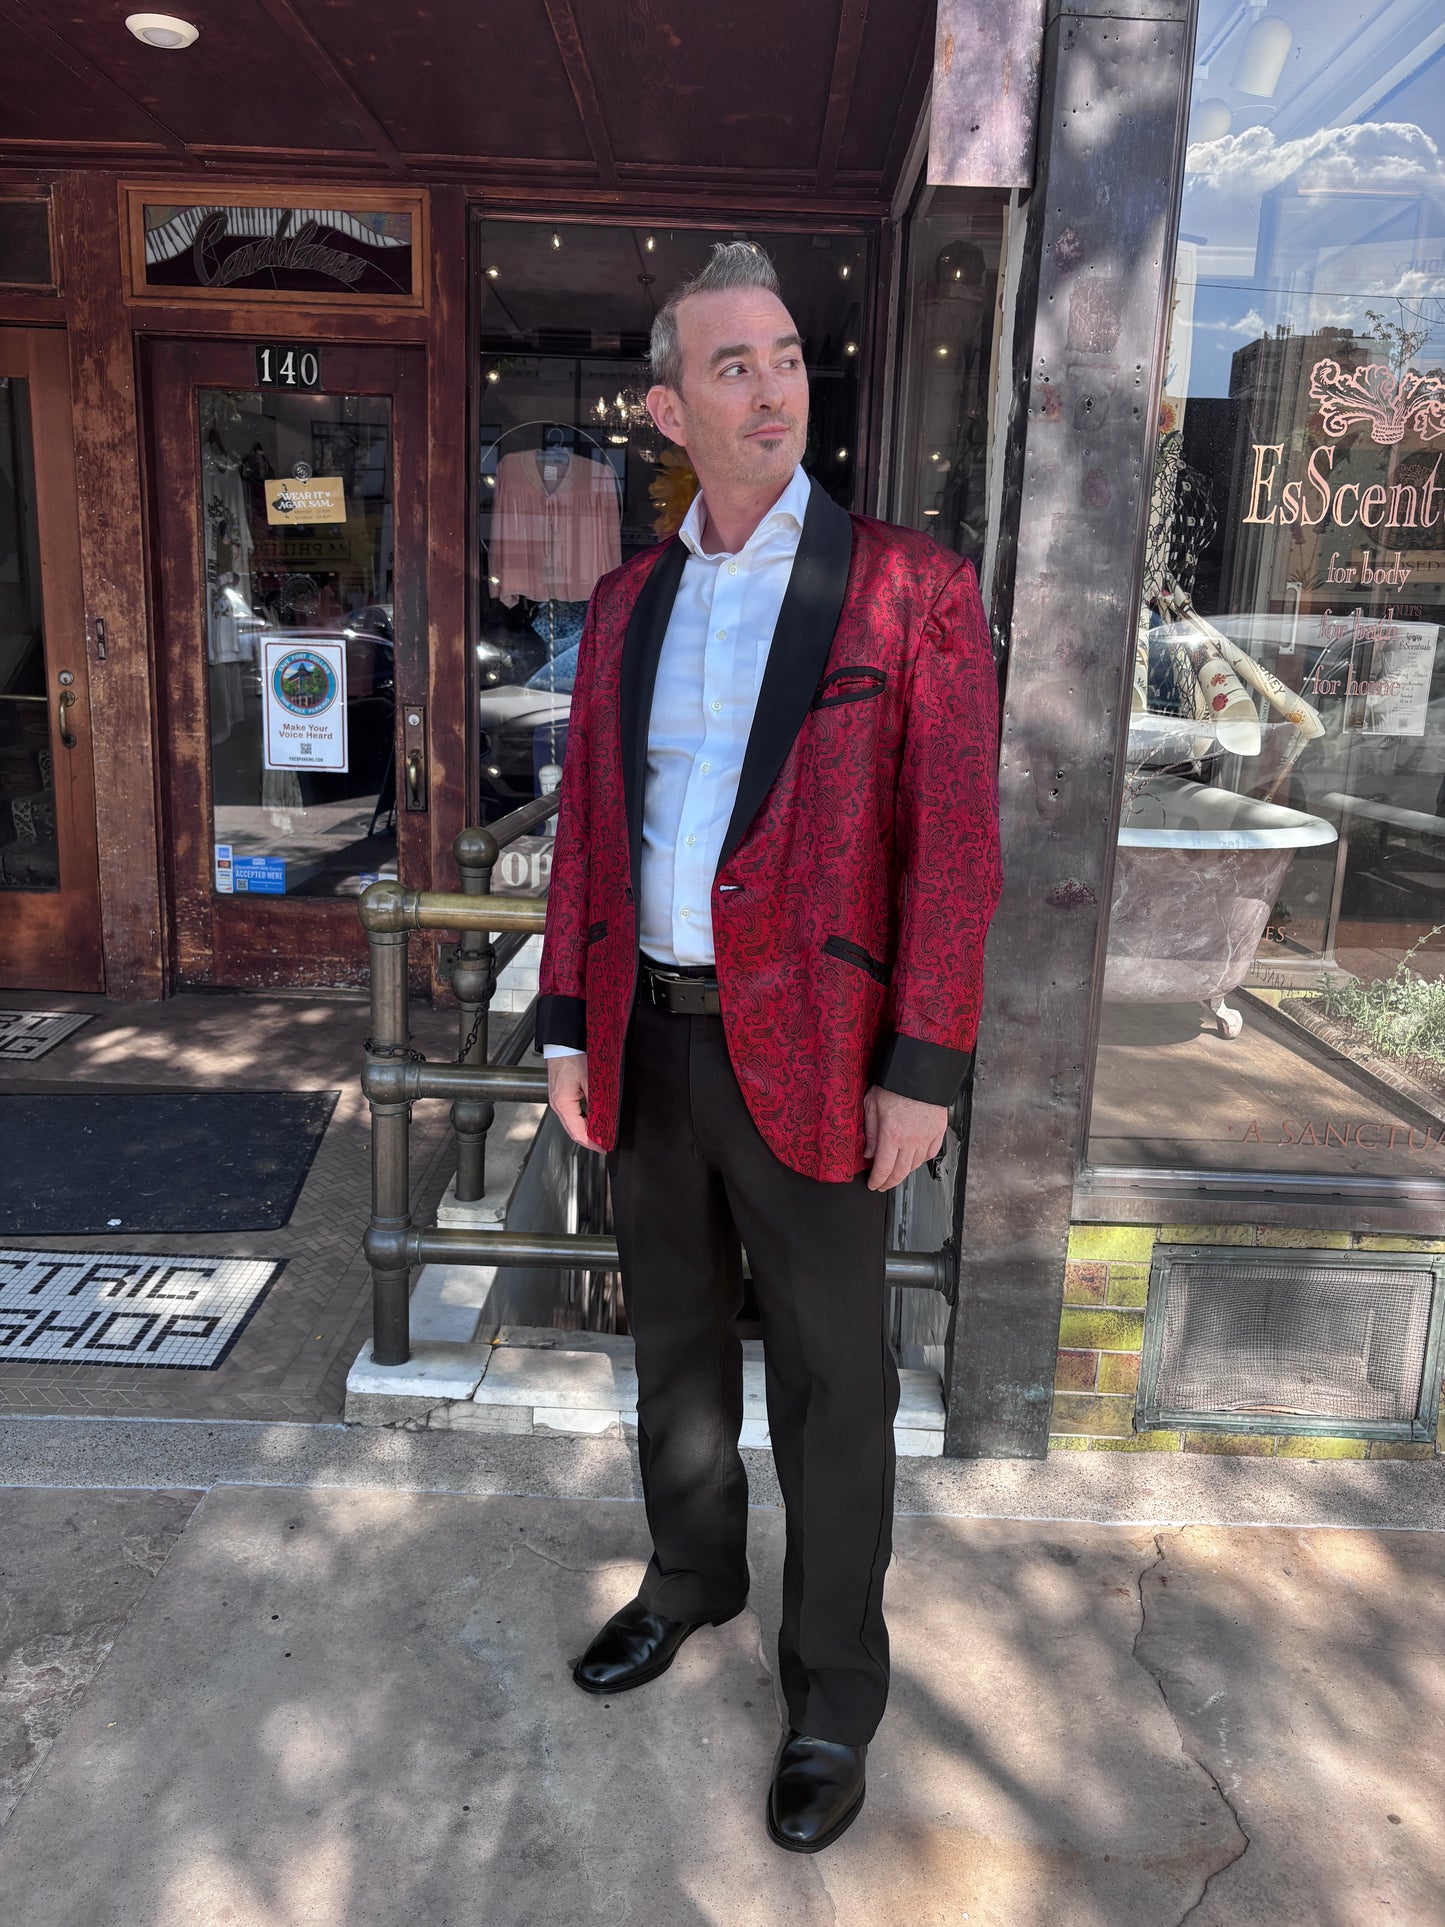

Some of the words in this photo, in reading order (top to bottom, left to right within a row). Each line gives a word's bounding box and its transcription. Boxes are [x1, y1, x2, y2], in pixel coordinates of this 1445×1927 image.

[260, 349, 318, 386] 140
[277, 491, 311, 500] WEAR
[313, 491, 324, 499] IT
[278, 501, 306, 510] AGAIN
[1326, 552, 1357, 584] for
[1361, 551, 1412, 592] body
[1318, 608, 1348, 640] for
[1354, 607, 1399, 641] bath
[1312, 664, 1340, 695] for
[1344, 663, 1400, 696] home
[279, 731, 303, 739] Voice
[306, 731, 333, 740] Heard
[283, 723, 306, 732] Make
[308, 724, 328, 732] Your
[235, 870, 267, 879] ACCEPTED
[267, 872, 283, 880] HERE
[1242, 1119, 1263, 1144] A
